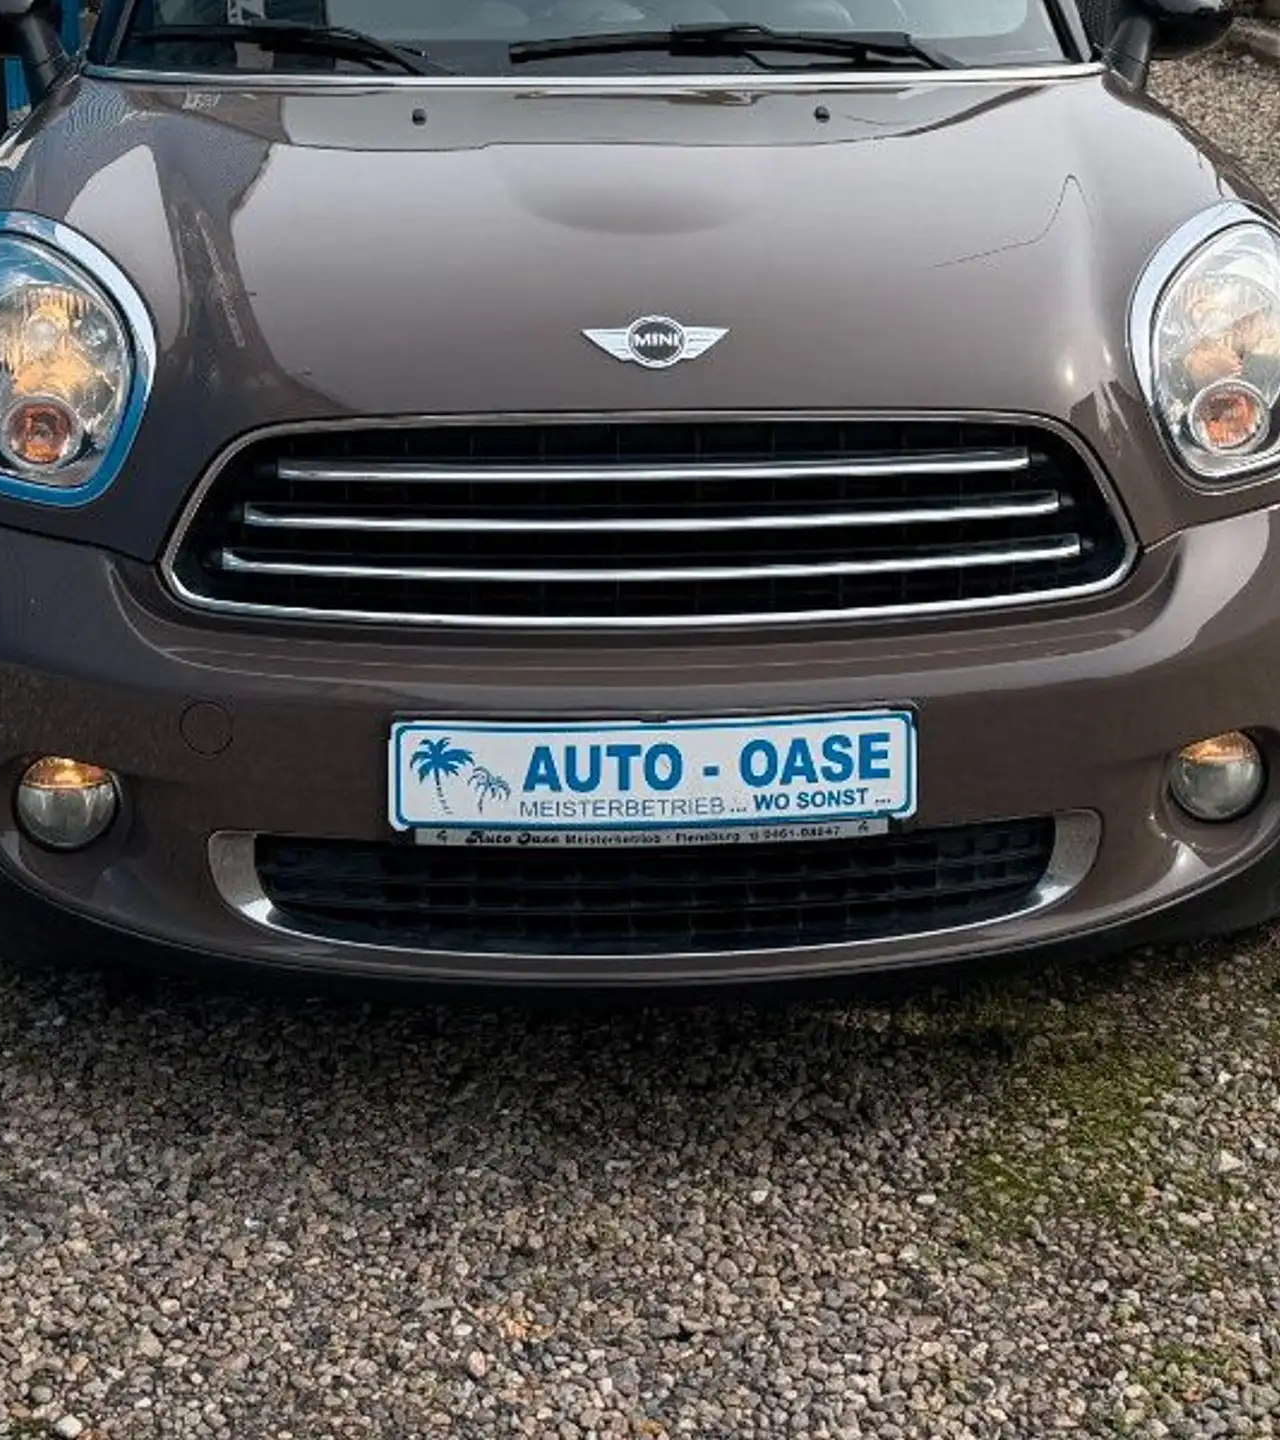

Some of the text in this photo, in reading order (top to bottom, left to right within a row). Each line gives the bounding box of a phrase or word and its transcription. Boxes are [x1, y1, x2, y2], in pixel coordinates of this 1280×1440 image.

[635, 332, 680, 347] MINI
[523, 742, 683, 793] AUTO
[739, 732, 891, 788] OASE
[753, 792, 791, 811] WO
[796, 787, 869, 809] SONST
